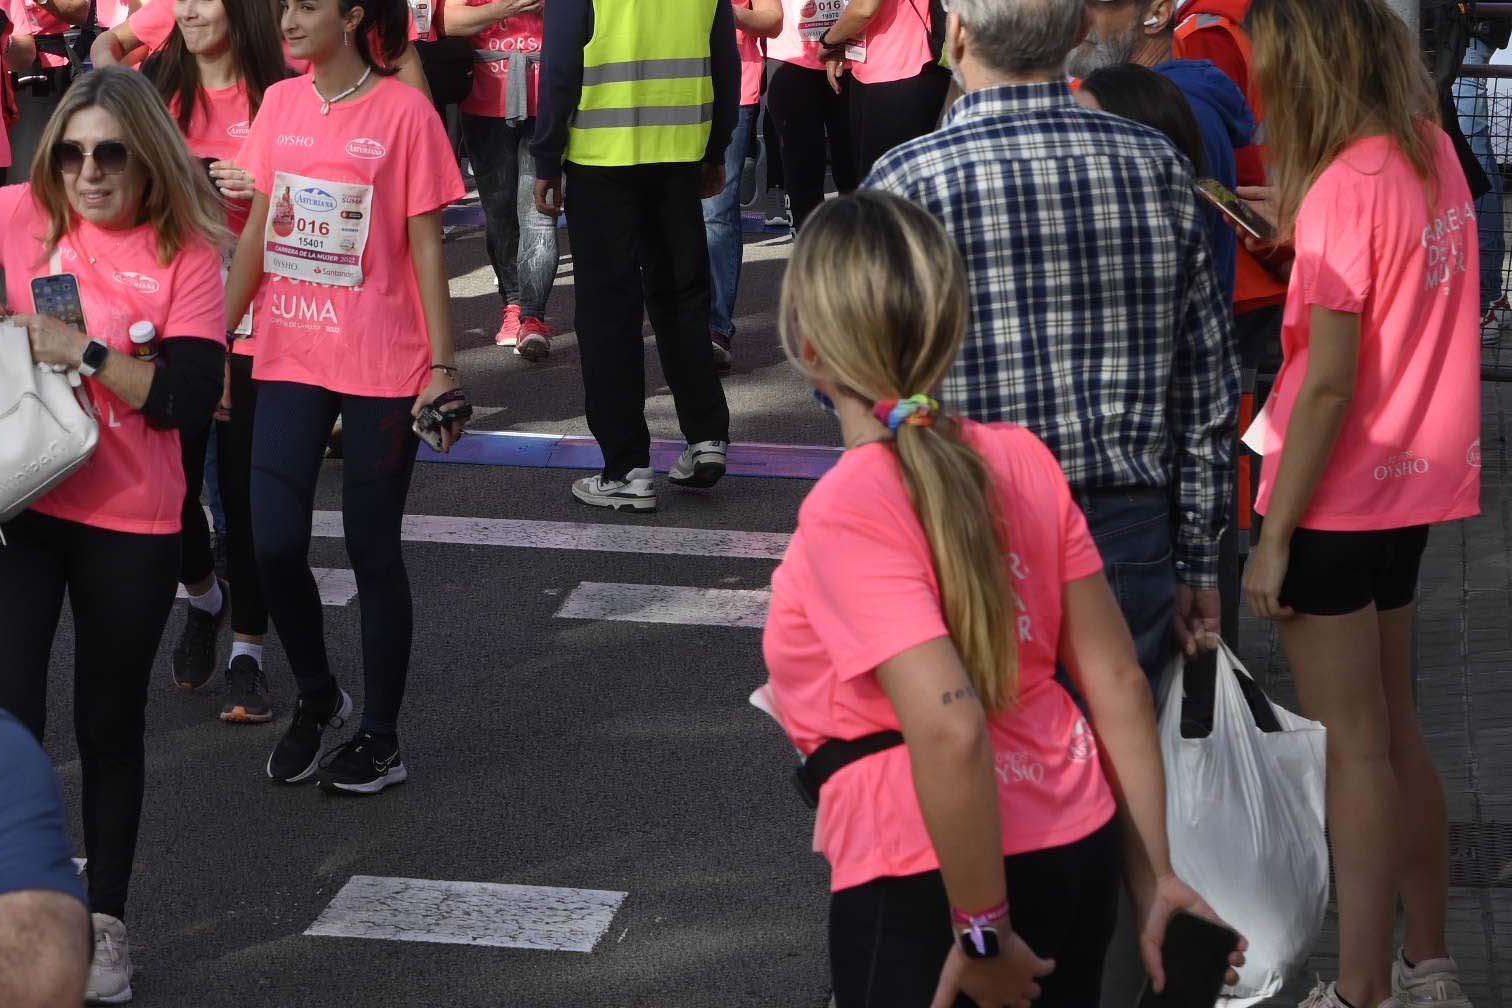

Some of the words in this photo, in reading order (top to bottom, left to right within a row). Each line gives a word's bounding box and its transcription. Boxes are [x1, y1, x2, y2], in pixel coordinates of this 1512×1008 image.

[818, 0, 841, 11] 016
[276, 134, 314, 148] OYSHO
[297, 194, 336, 209] ASTURIANA
[296, 217, 330, 236] 016
[298, 236, 324, 249] 15401
[275, 244, 299, 257] CARRERA
[299, 249, 307, 258] DE
[308, 251, 316, 259] LA
[316, 252, 339, 262] MUJER
[273, 257, 298, 271] OYSHO
[272, 292, 338, 324] SUMA
